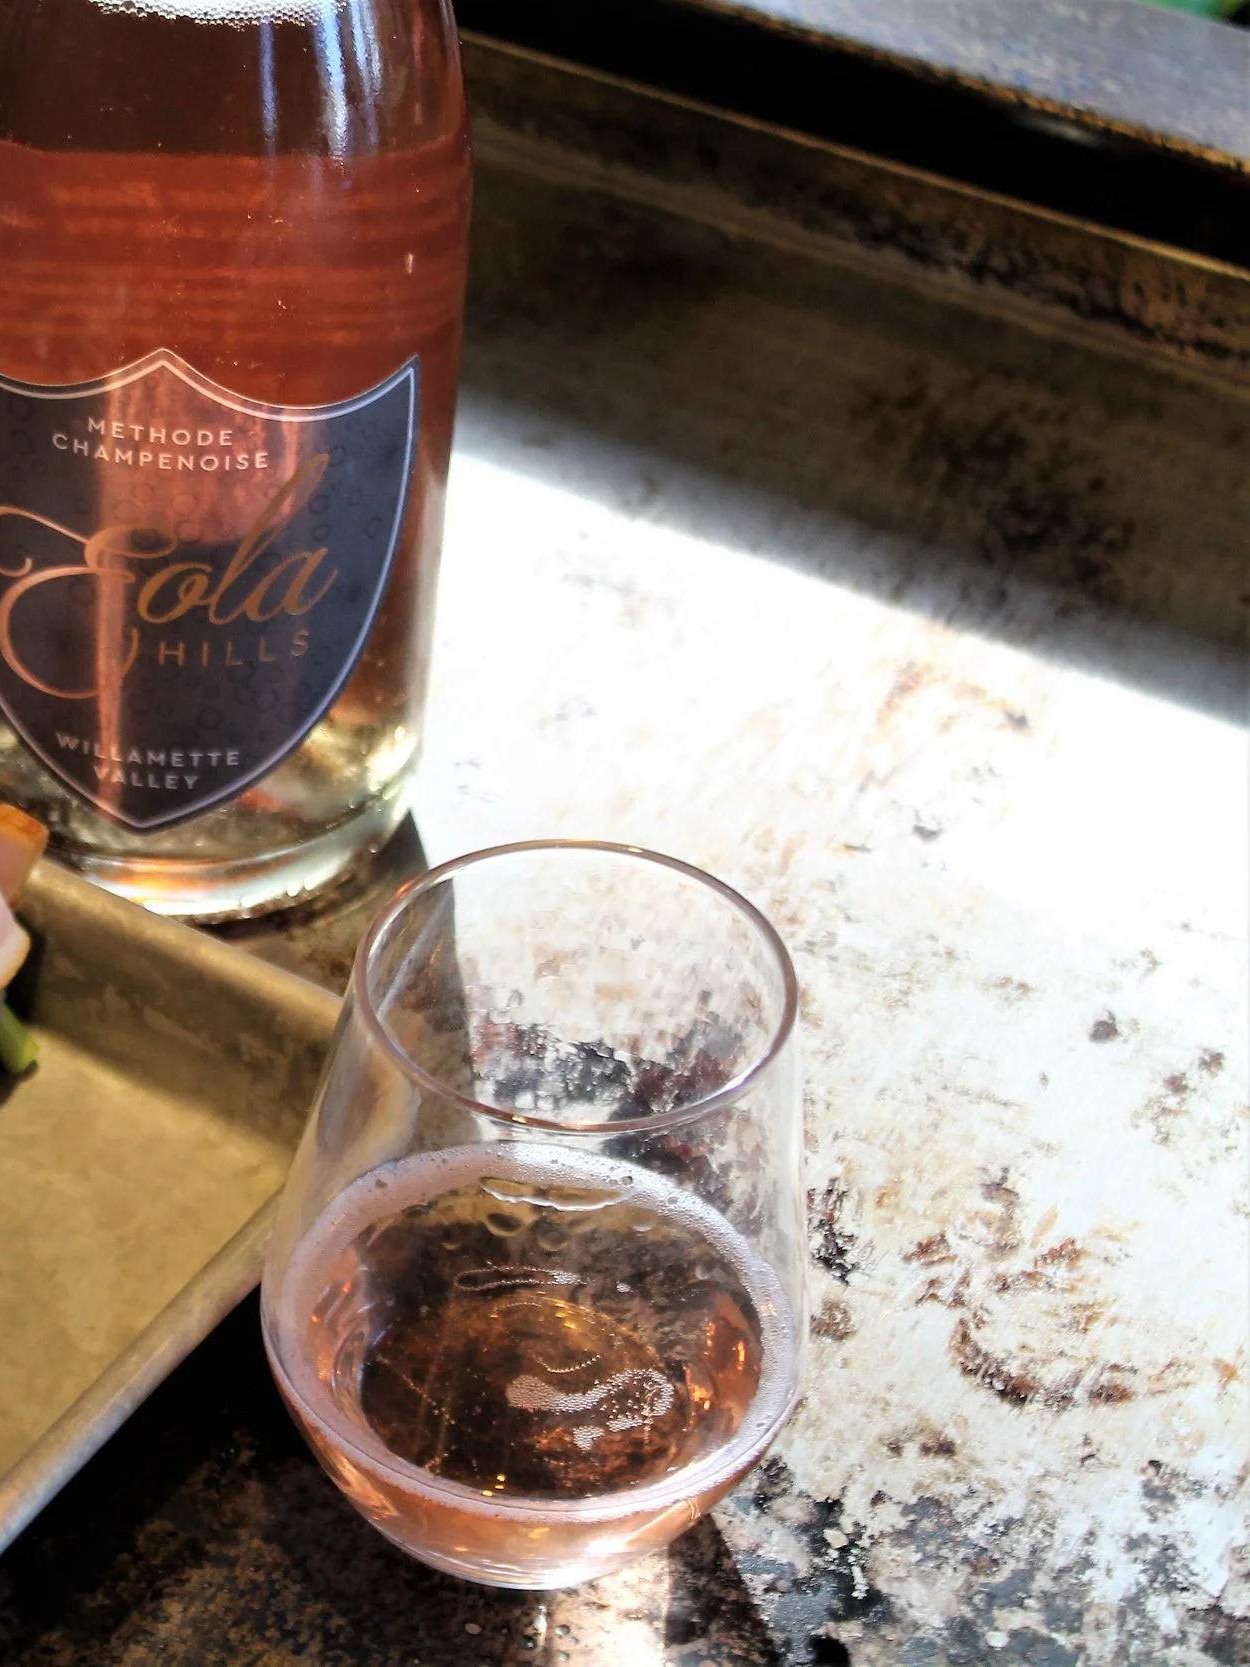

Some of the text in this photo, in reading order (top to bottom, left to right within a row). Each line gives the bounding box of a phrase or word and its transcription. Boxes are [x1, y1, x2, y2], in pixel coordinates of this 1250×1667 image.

[87, 416, 234, 446] METHODE
[51, 432, 269, 472] CHAMPENOISE
[158, 629, 311, 667] HILLS
[55, 731, 240, 768] WILLAMETTE
[93, 765, 201, 790] VALLEY
